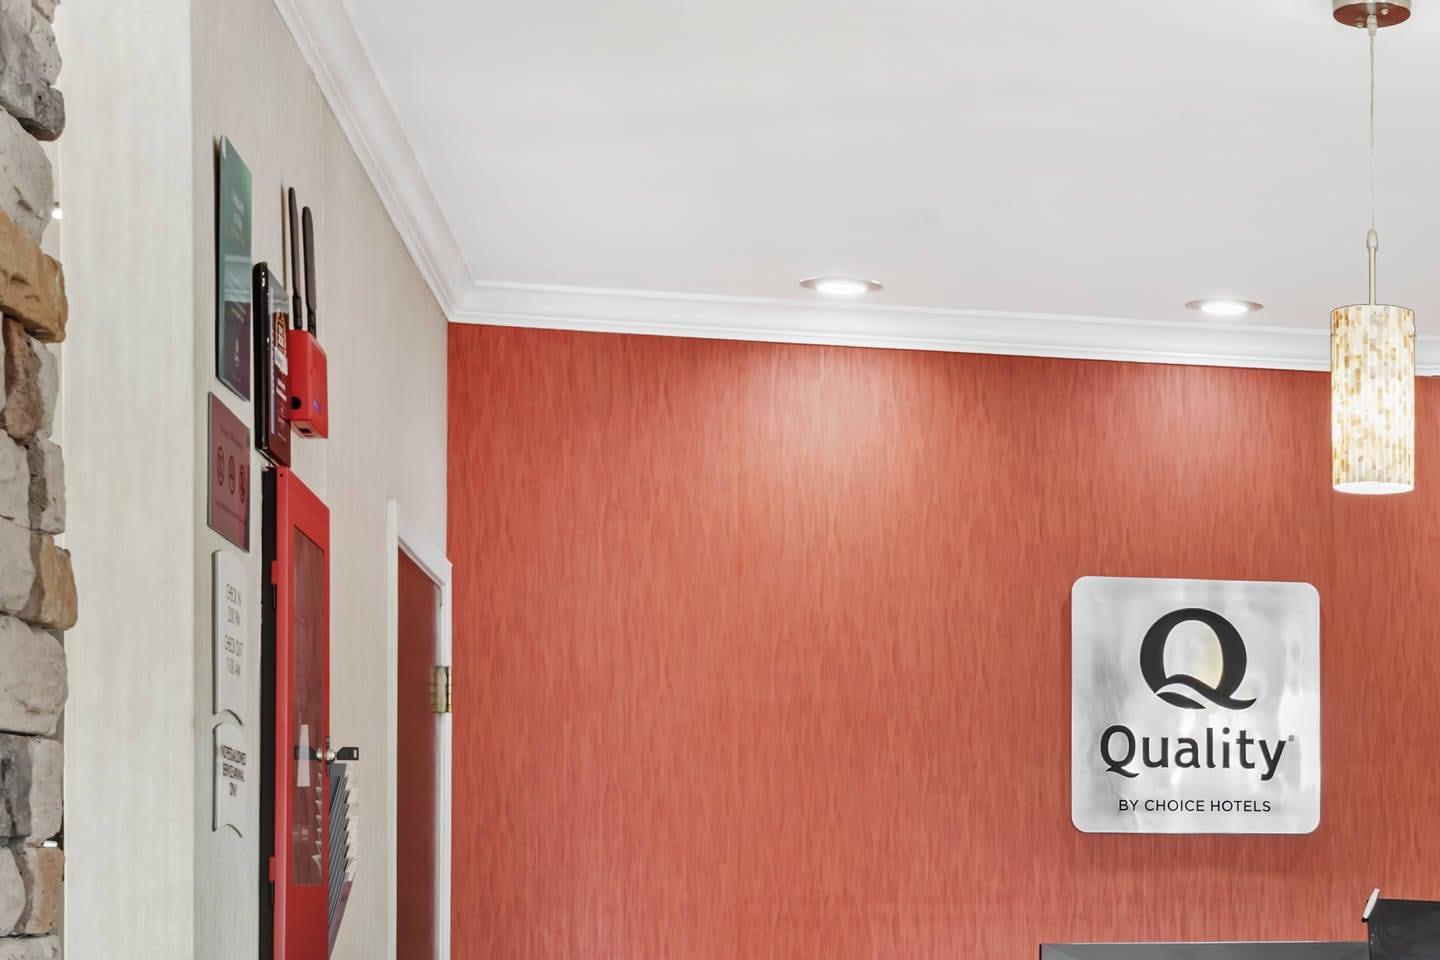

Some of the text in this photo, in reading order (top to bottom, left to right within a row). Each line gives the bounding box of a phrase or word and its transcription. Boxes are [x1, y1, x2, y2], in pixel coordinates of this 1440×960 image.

[1139, 607, 1257, 710] Q
[1100, 725, 1287, 781] Quality
[1119, 799, 1272, 812] BY CHOICE HOTELS
